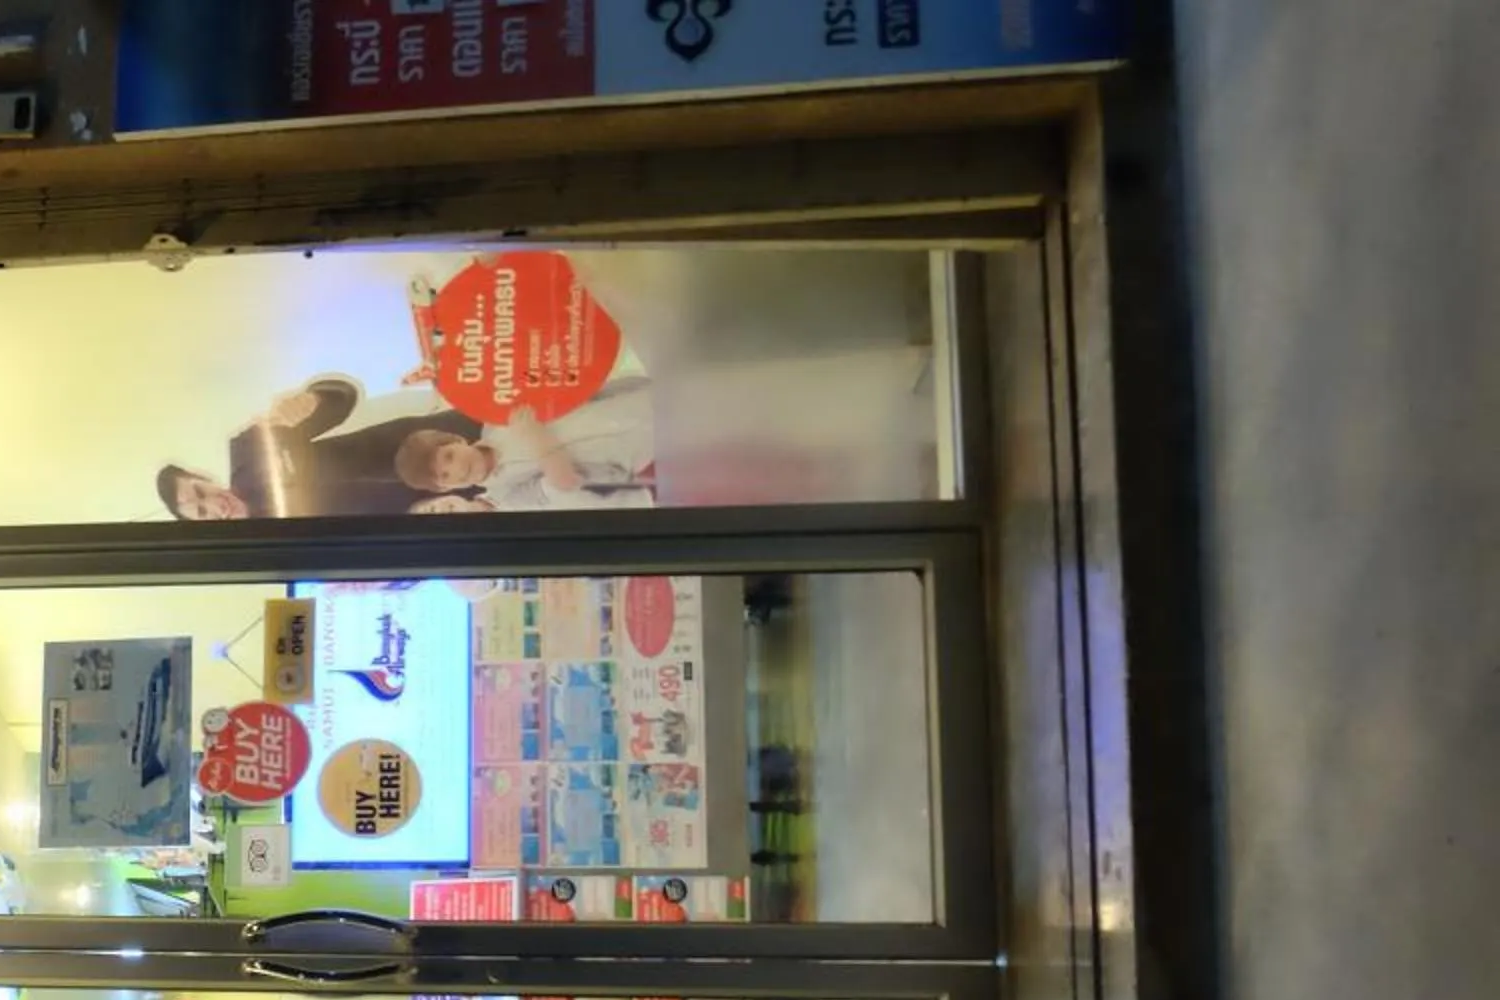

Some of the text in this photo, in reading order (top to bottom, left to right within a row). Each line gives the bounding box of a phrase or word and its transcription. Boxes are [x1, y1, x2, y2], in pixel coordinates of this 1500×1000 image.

[336, 19, 382, 85] กระบี่
[397, 24, 426, 82] ราคา
[500, 15, 529, 74] ราคา
[492, 268, 521, 404] คุณภาพครบ
[291, 615, 308, 656] OPEN
[657, 665, 682, 702] 490
[235, 718, 260, 785] BUY
[260, 713, 283, 791] HERE
[355, 790, 377, 835] BUY
[379, 753, 401, 819] HERE!
